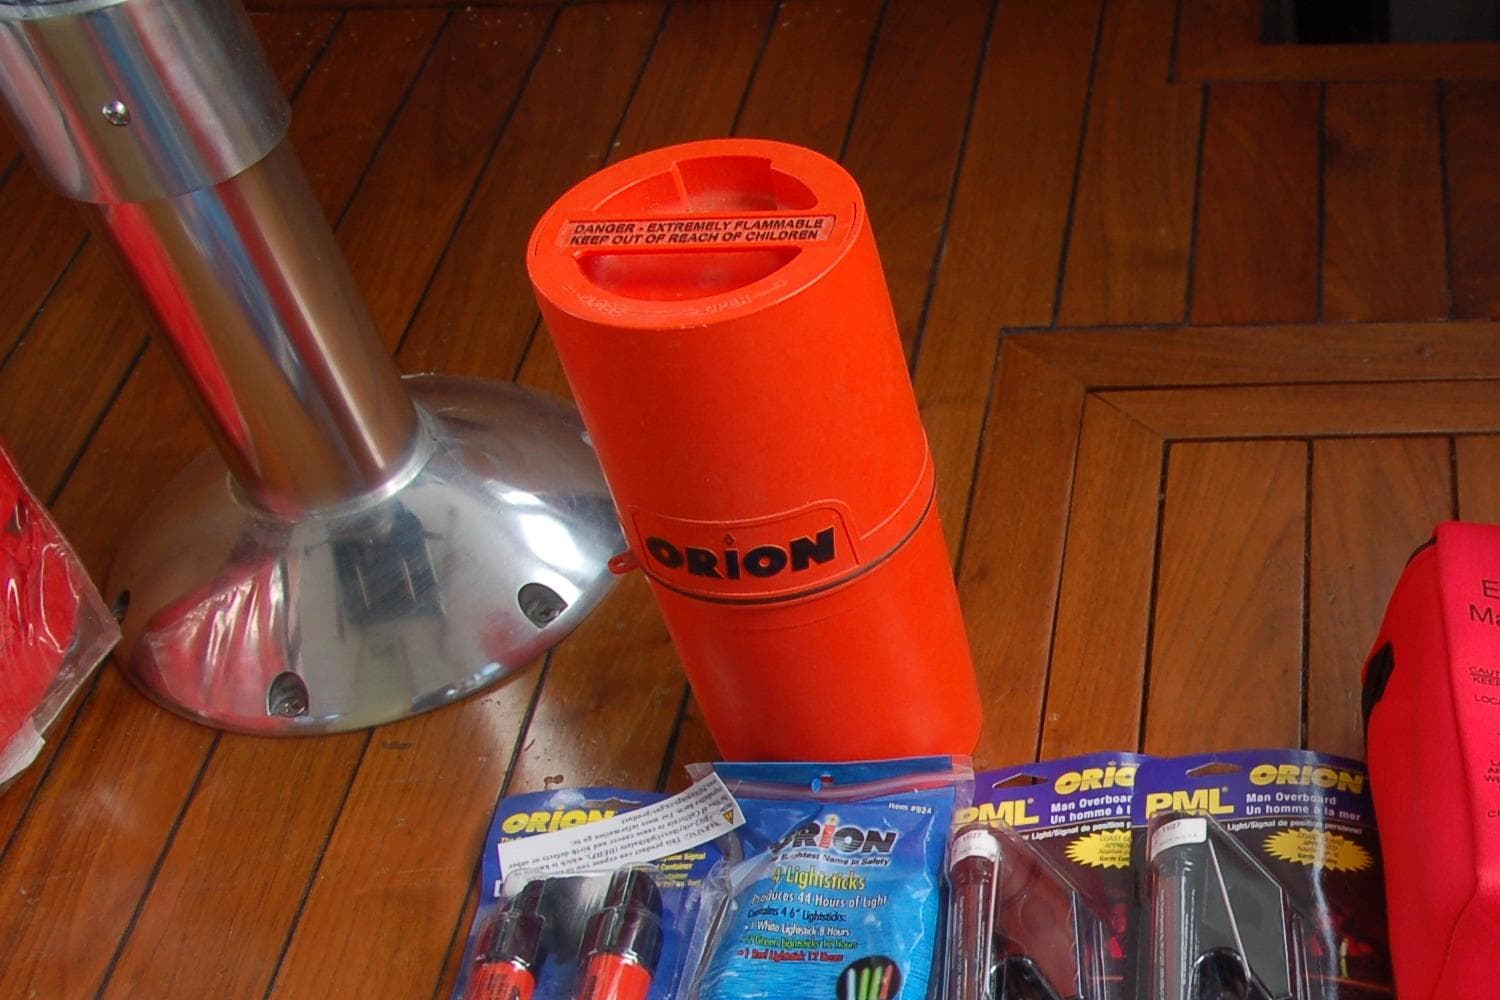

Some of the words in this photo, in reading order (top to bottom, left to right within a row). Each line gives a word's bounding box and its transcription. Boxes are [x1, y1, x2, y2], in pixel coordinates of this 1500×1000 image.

[575, 223, 634, 234] DANGER
[647, 221, 731, 232] EXTREMELY
[734, 219, 824, 230] FLAMMABLE
[570, 235, 608, 245] KEEP
[611, 235, 641, 245] OUT
[641, 234, 665, 243] OF
[667, 232, 718, 243] REACH
[722, 232, 741, 241] OF
[745, 230, 818, 240] CHILDREN
[645, 526, 836, 580] ORION
[1249, 764, 1364, 795] ORION
[888, 802, 908, 811] Item
[1146, 788, 1235, 820] PML
[1246, 793, 1269, 804] Man
[1271, 792, 1337, 806] Overboard
[953, 800, 1040, 829] PML
[1246, 805, 1261, 815] Un
[1264, 803, 1310, 815] homme
[785, 866, 866, 891] Lightsticks
[798, 893, 811, 904] 44
[815, 893, 845, 907] Hours
[849, 895, 860, 907] of
[863, 896, 887, 907] Light
